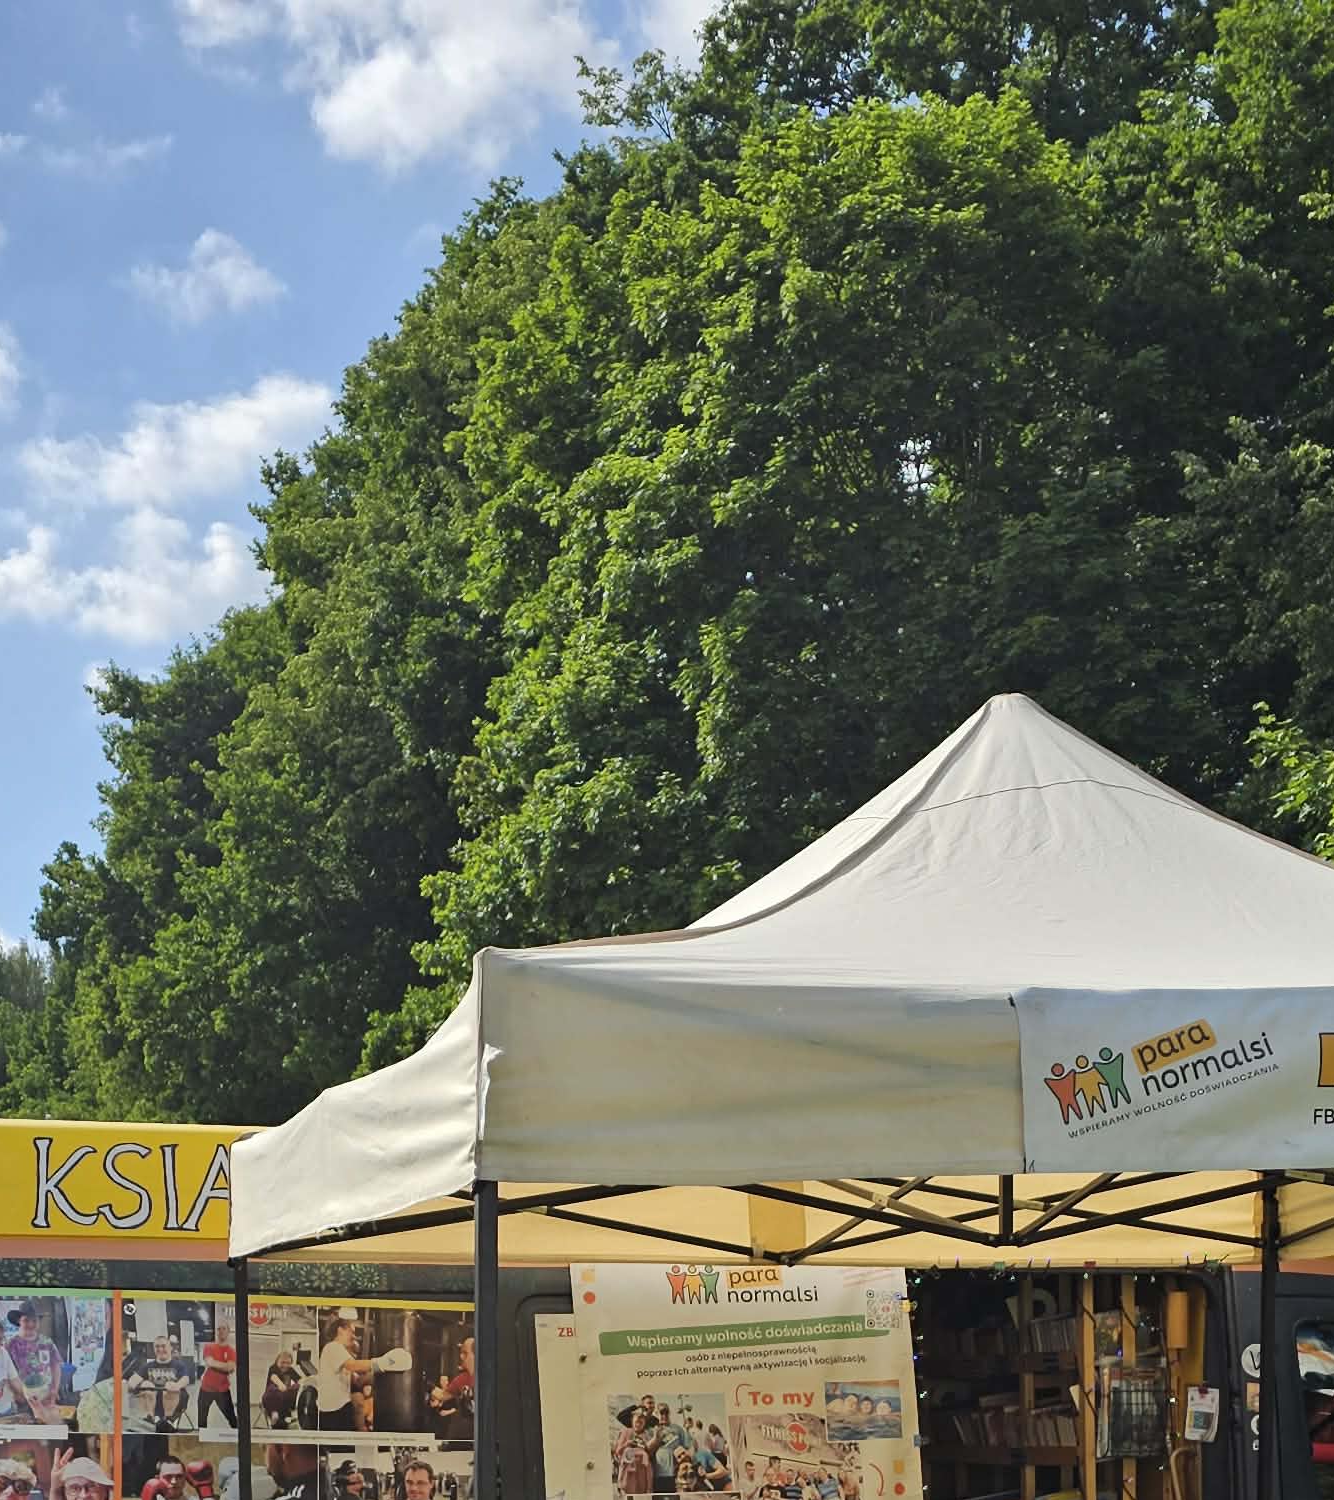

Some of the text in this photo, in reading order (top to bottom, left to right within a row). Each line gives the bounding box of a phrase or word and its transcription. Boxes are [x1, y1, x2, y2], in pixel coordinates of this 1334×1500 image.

[1137, 1022, 1210, 1072] para
[1142, 1031, 1275, 1096] normalsi
[1068, 1112, 1131, 1139] WSPIERAMY
[31, 1136, 230, 1231] KSIA
[729, 1268, 779, 1288] para
[727, 1286, 818, 1303] normalsi
[557, 1327, 576, 1338] ZB
[626, 1320, 863, 1349] Wspieramy wolność doświadczania
[686, 1353, 709, 1362] osób
[637, 1368, 673, 1378] poprzez
[748, 1391, 815, 1408] To my
